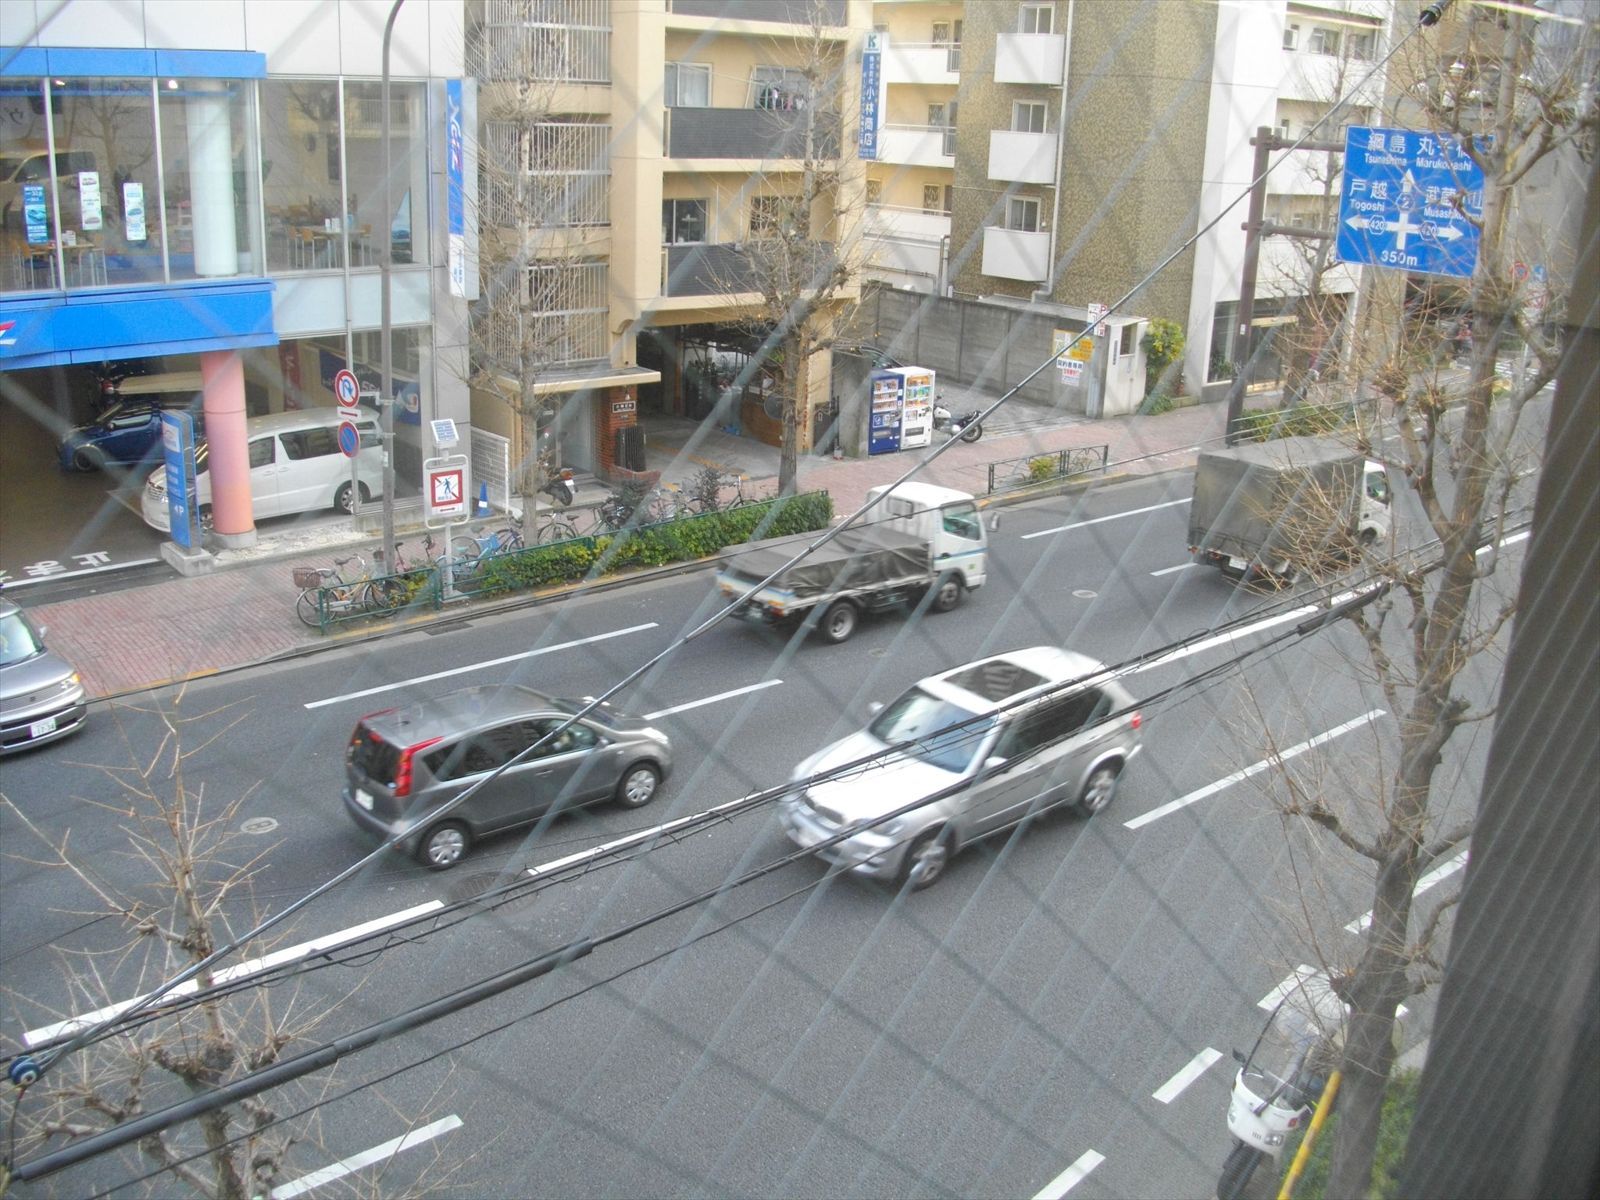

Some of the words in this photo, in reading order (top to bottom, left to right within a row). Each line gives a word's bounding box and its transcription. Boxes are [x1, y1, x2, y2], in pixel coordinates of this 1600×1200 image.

[1416, 157, 1472, 172] Marukoashi
[1349, 178, 1388, 200] 戸越
[1350, 198, 1385, 212] Togoshi
[1381, 251, 1418, 266] 350m
